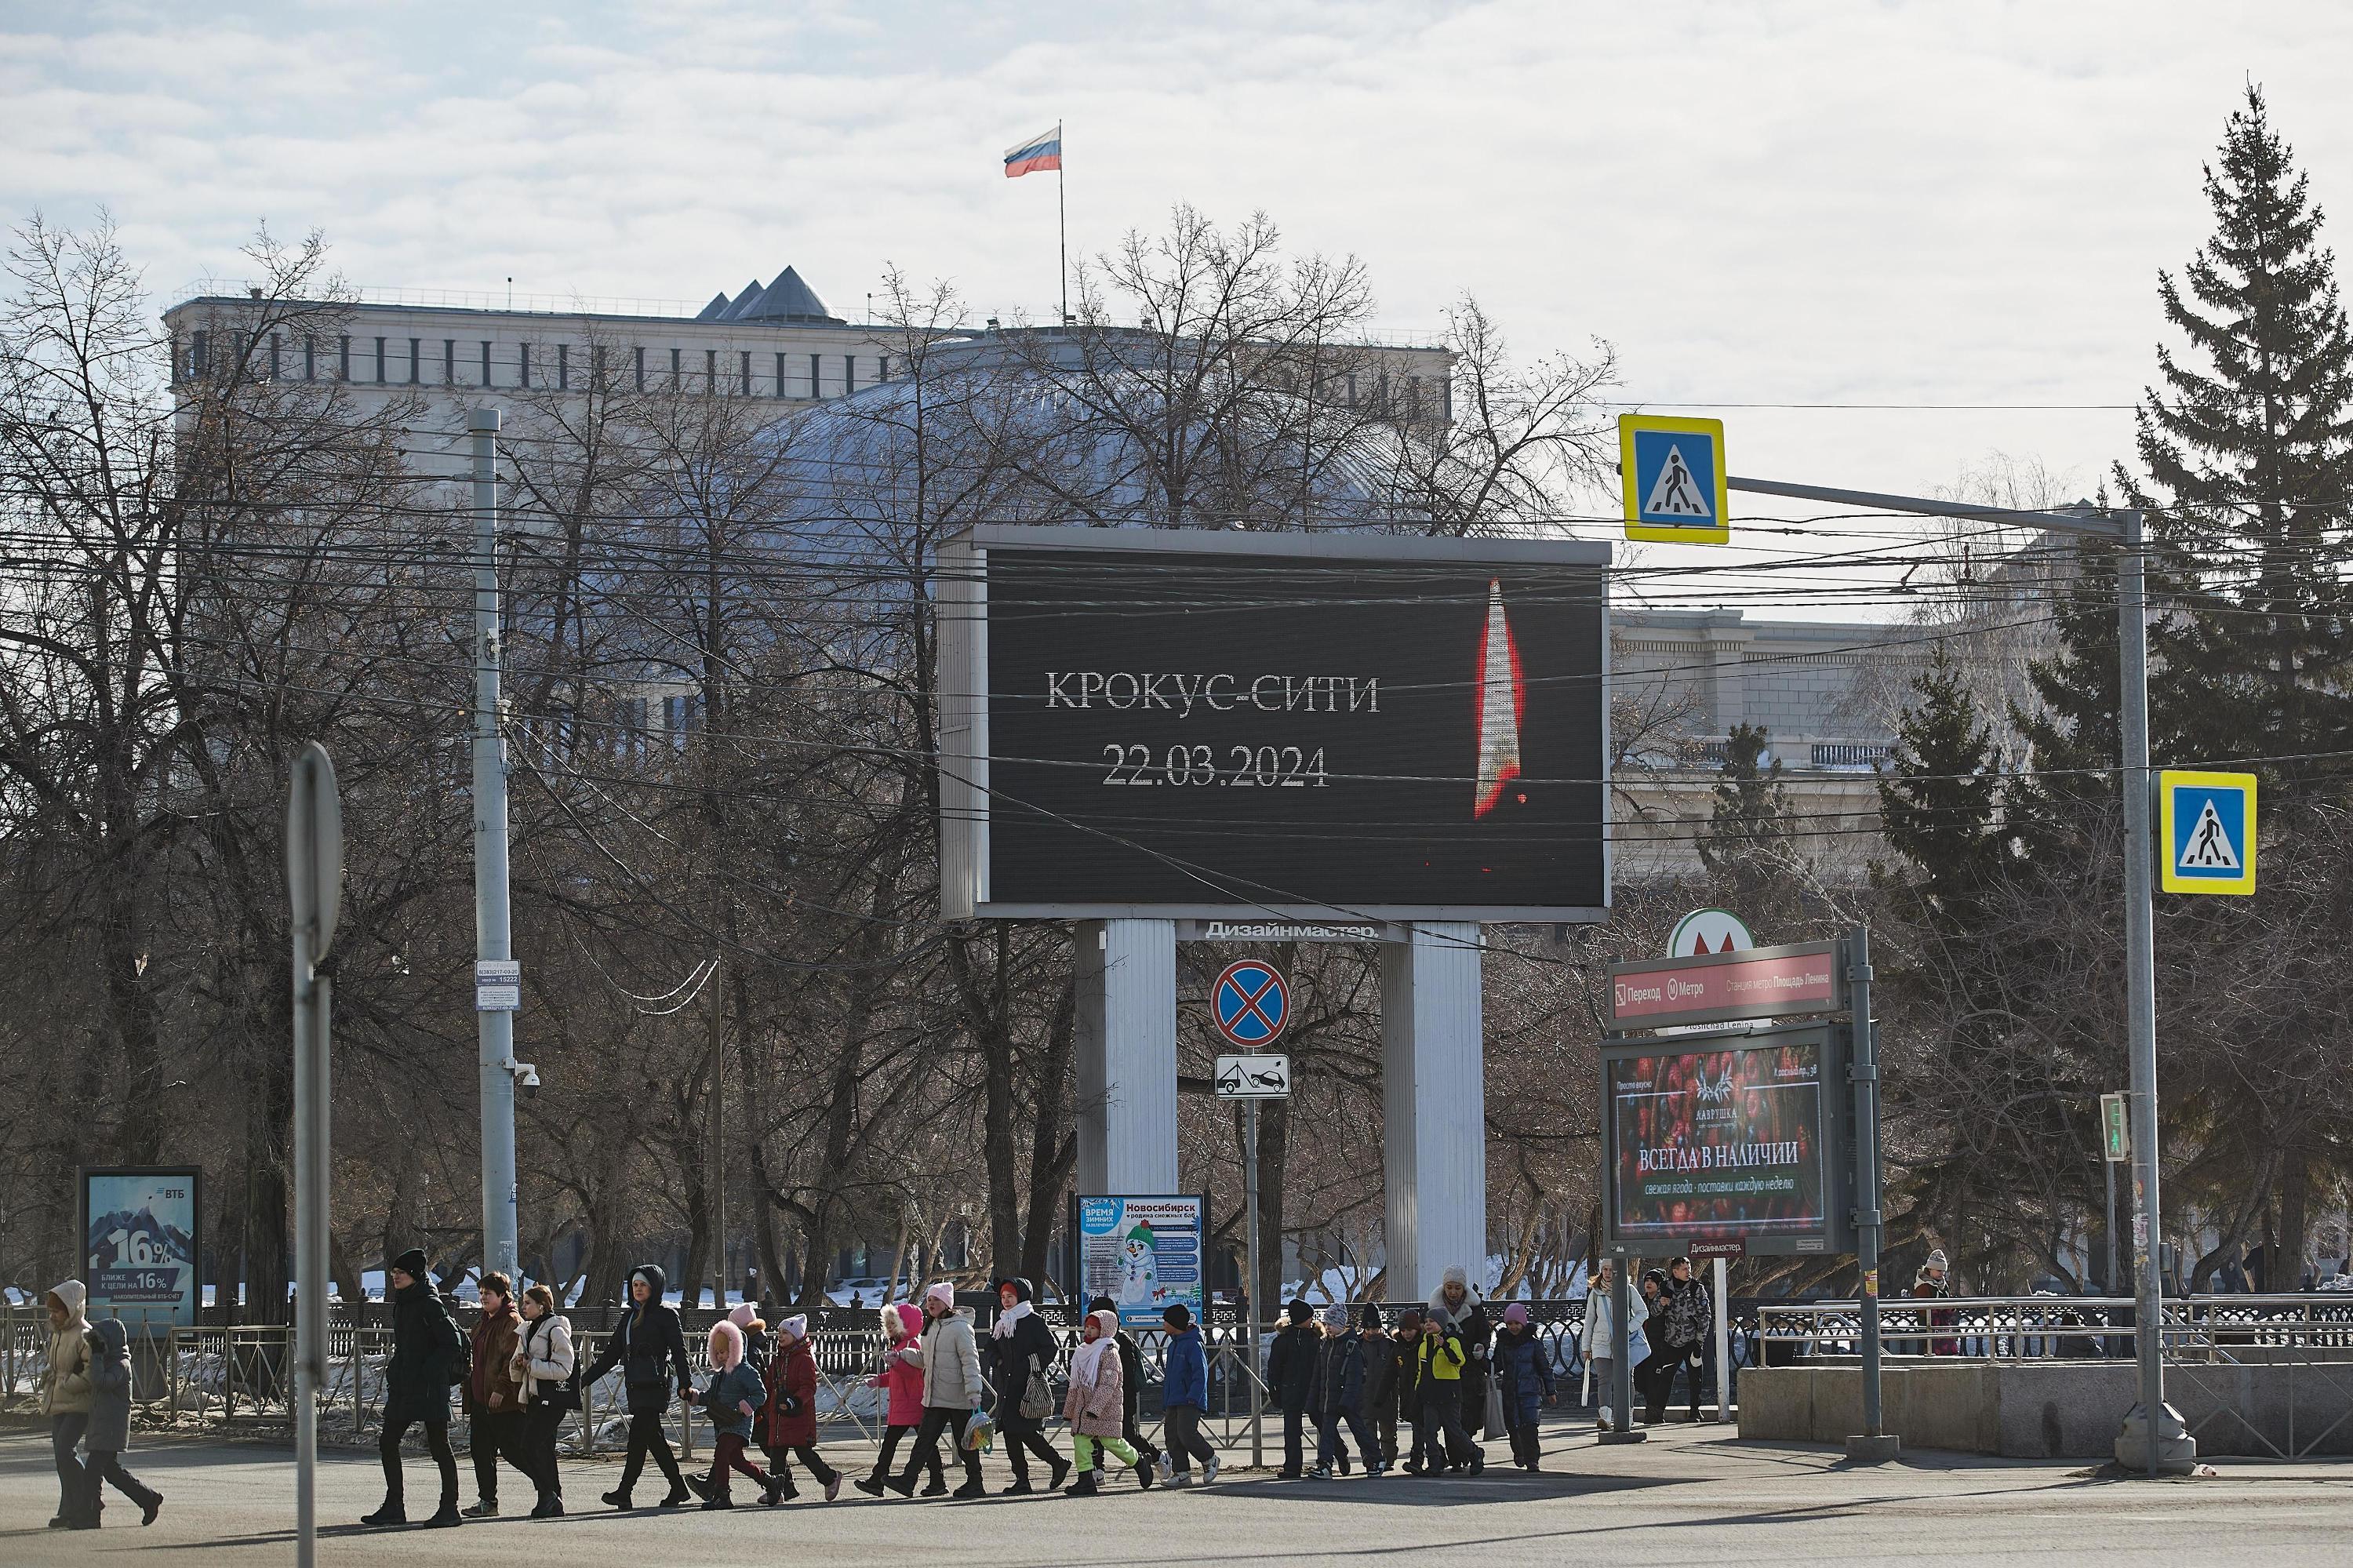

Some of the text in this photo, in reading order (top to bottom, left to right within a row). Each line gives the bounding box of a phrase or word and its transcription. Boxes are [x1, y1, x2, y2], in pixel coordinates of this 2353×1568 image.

[1044, 671, 1381, 719] КРОКУС-СИТИ
[1102, 744, 1330, 787] 22.03.2024
[1678, 981, 1704, 998] Метро
[1726, 973, 1829, 992] Станция метро Площадь Ленина
[1627, 987, 1661, 1004] Переход
[1695, 1108, 1737, 1121] ЛАВРУШКА
[1639, 1141, 1798, 1173] ВСЕГДА В НАЛИЧИИ
[165, 1189, 184, 1199] ВТБ
[1645, 1176, 1795, 1195] свежая ягода поставки каждую неделю
[1126, 1203, 1195, 1213] Новосибирск
[107, 1228, 173, 1268] 16%
[136, 1272, 167, 1289] 16%
